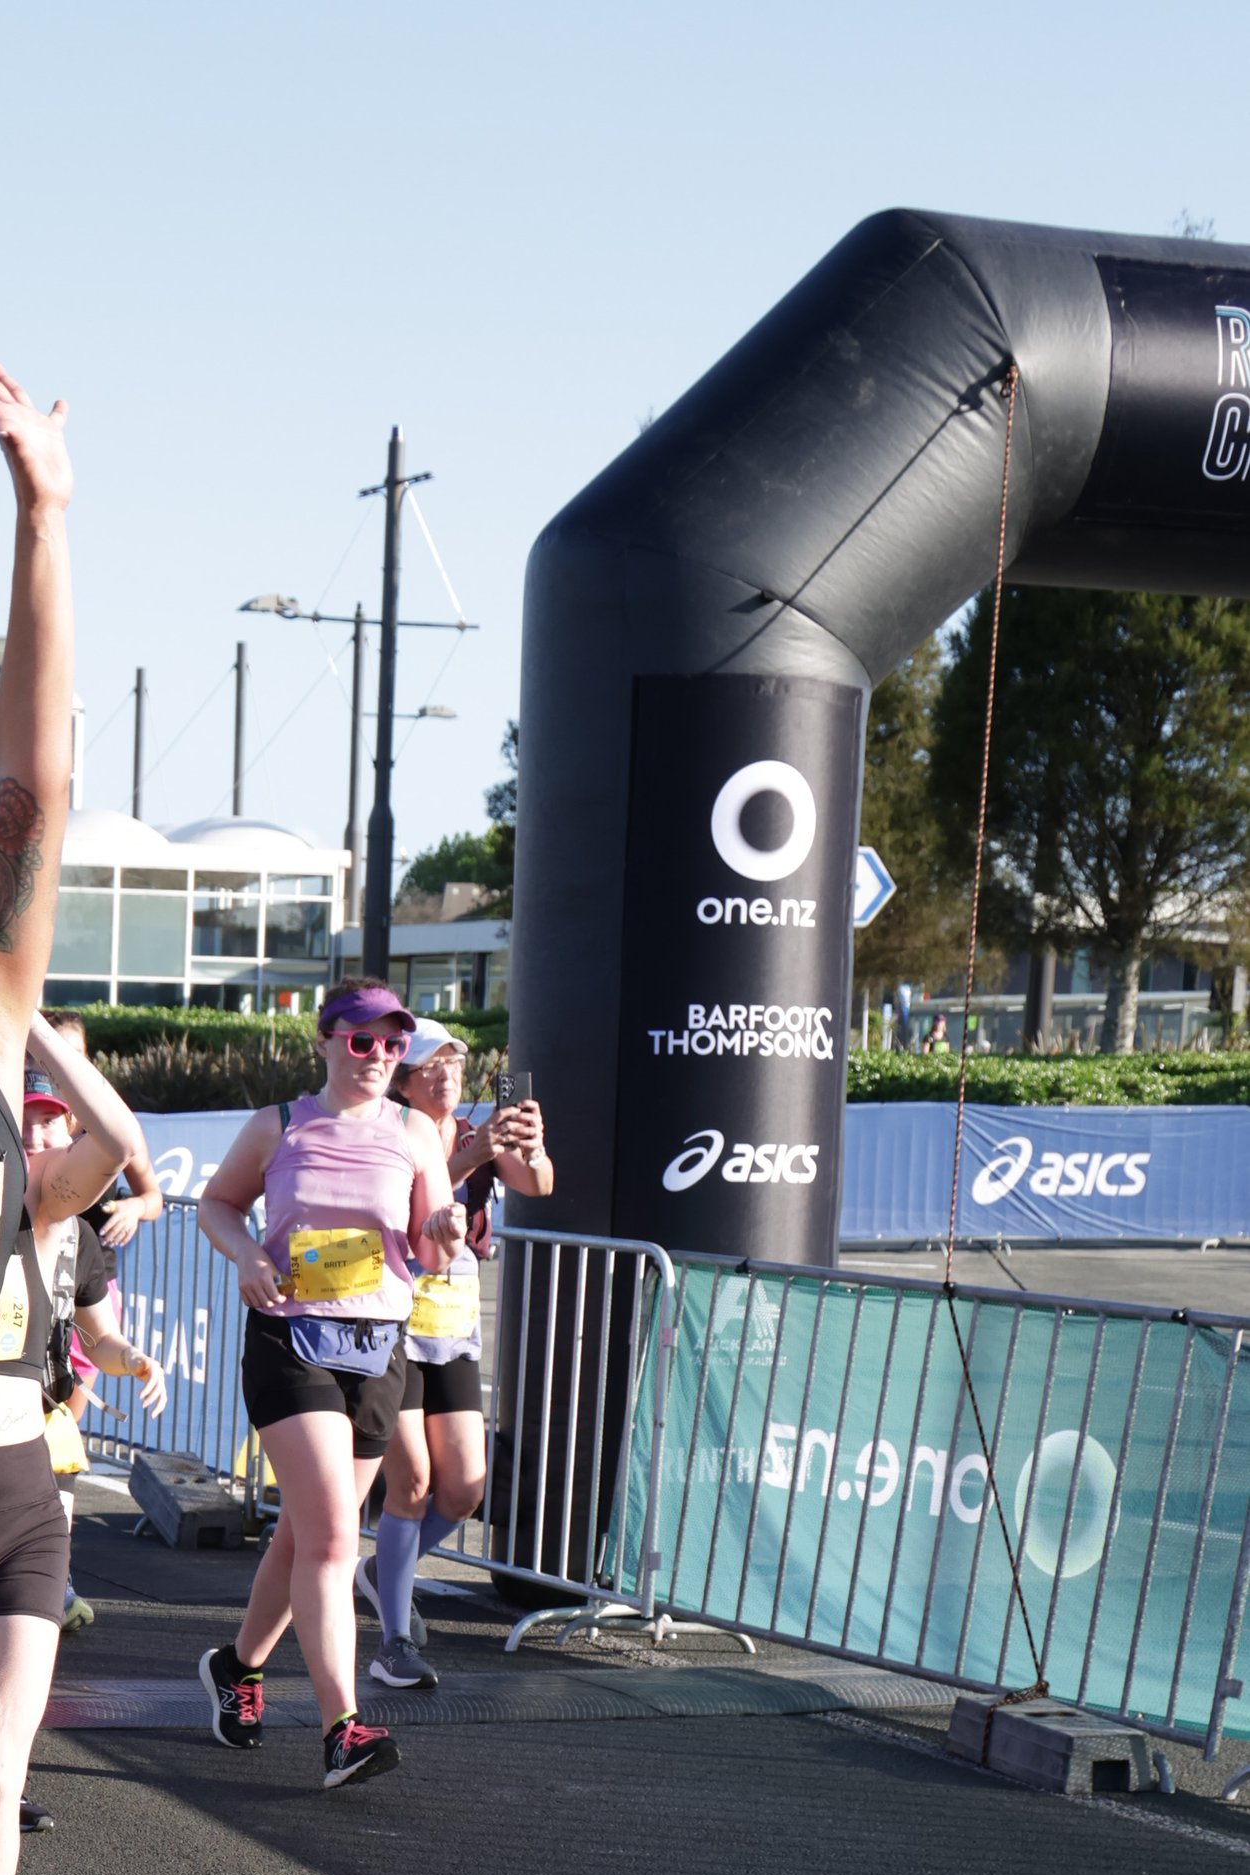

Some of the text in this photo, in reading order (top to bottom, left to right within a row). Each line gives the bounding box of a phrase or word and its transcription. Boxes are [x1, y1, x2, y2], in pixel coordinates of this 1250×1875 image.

[696, 897, 816, 928] one.nz
[688, 1004, 816, 1032] BARFOOT
[648, 1029, 812, 1057] THOMPSON
[722, 1143, 819, 1184] asics
[1029, 1152, 1151, 1197] asics
[291, 1256, 300, 1279] 3134
[324, 1260, 347, 1269] BRITT
